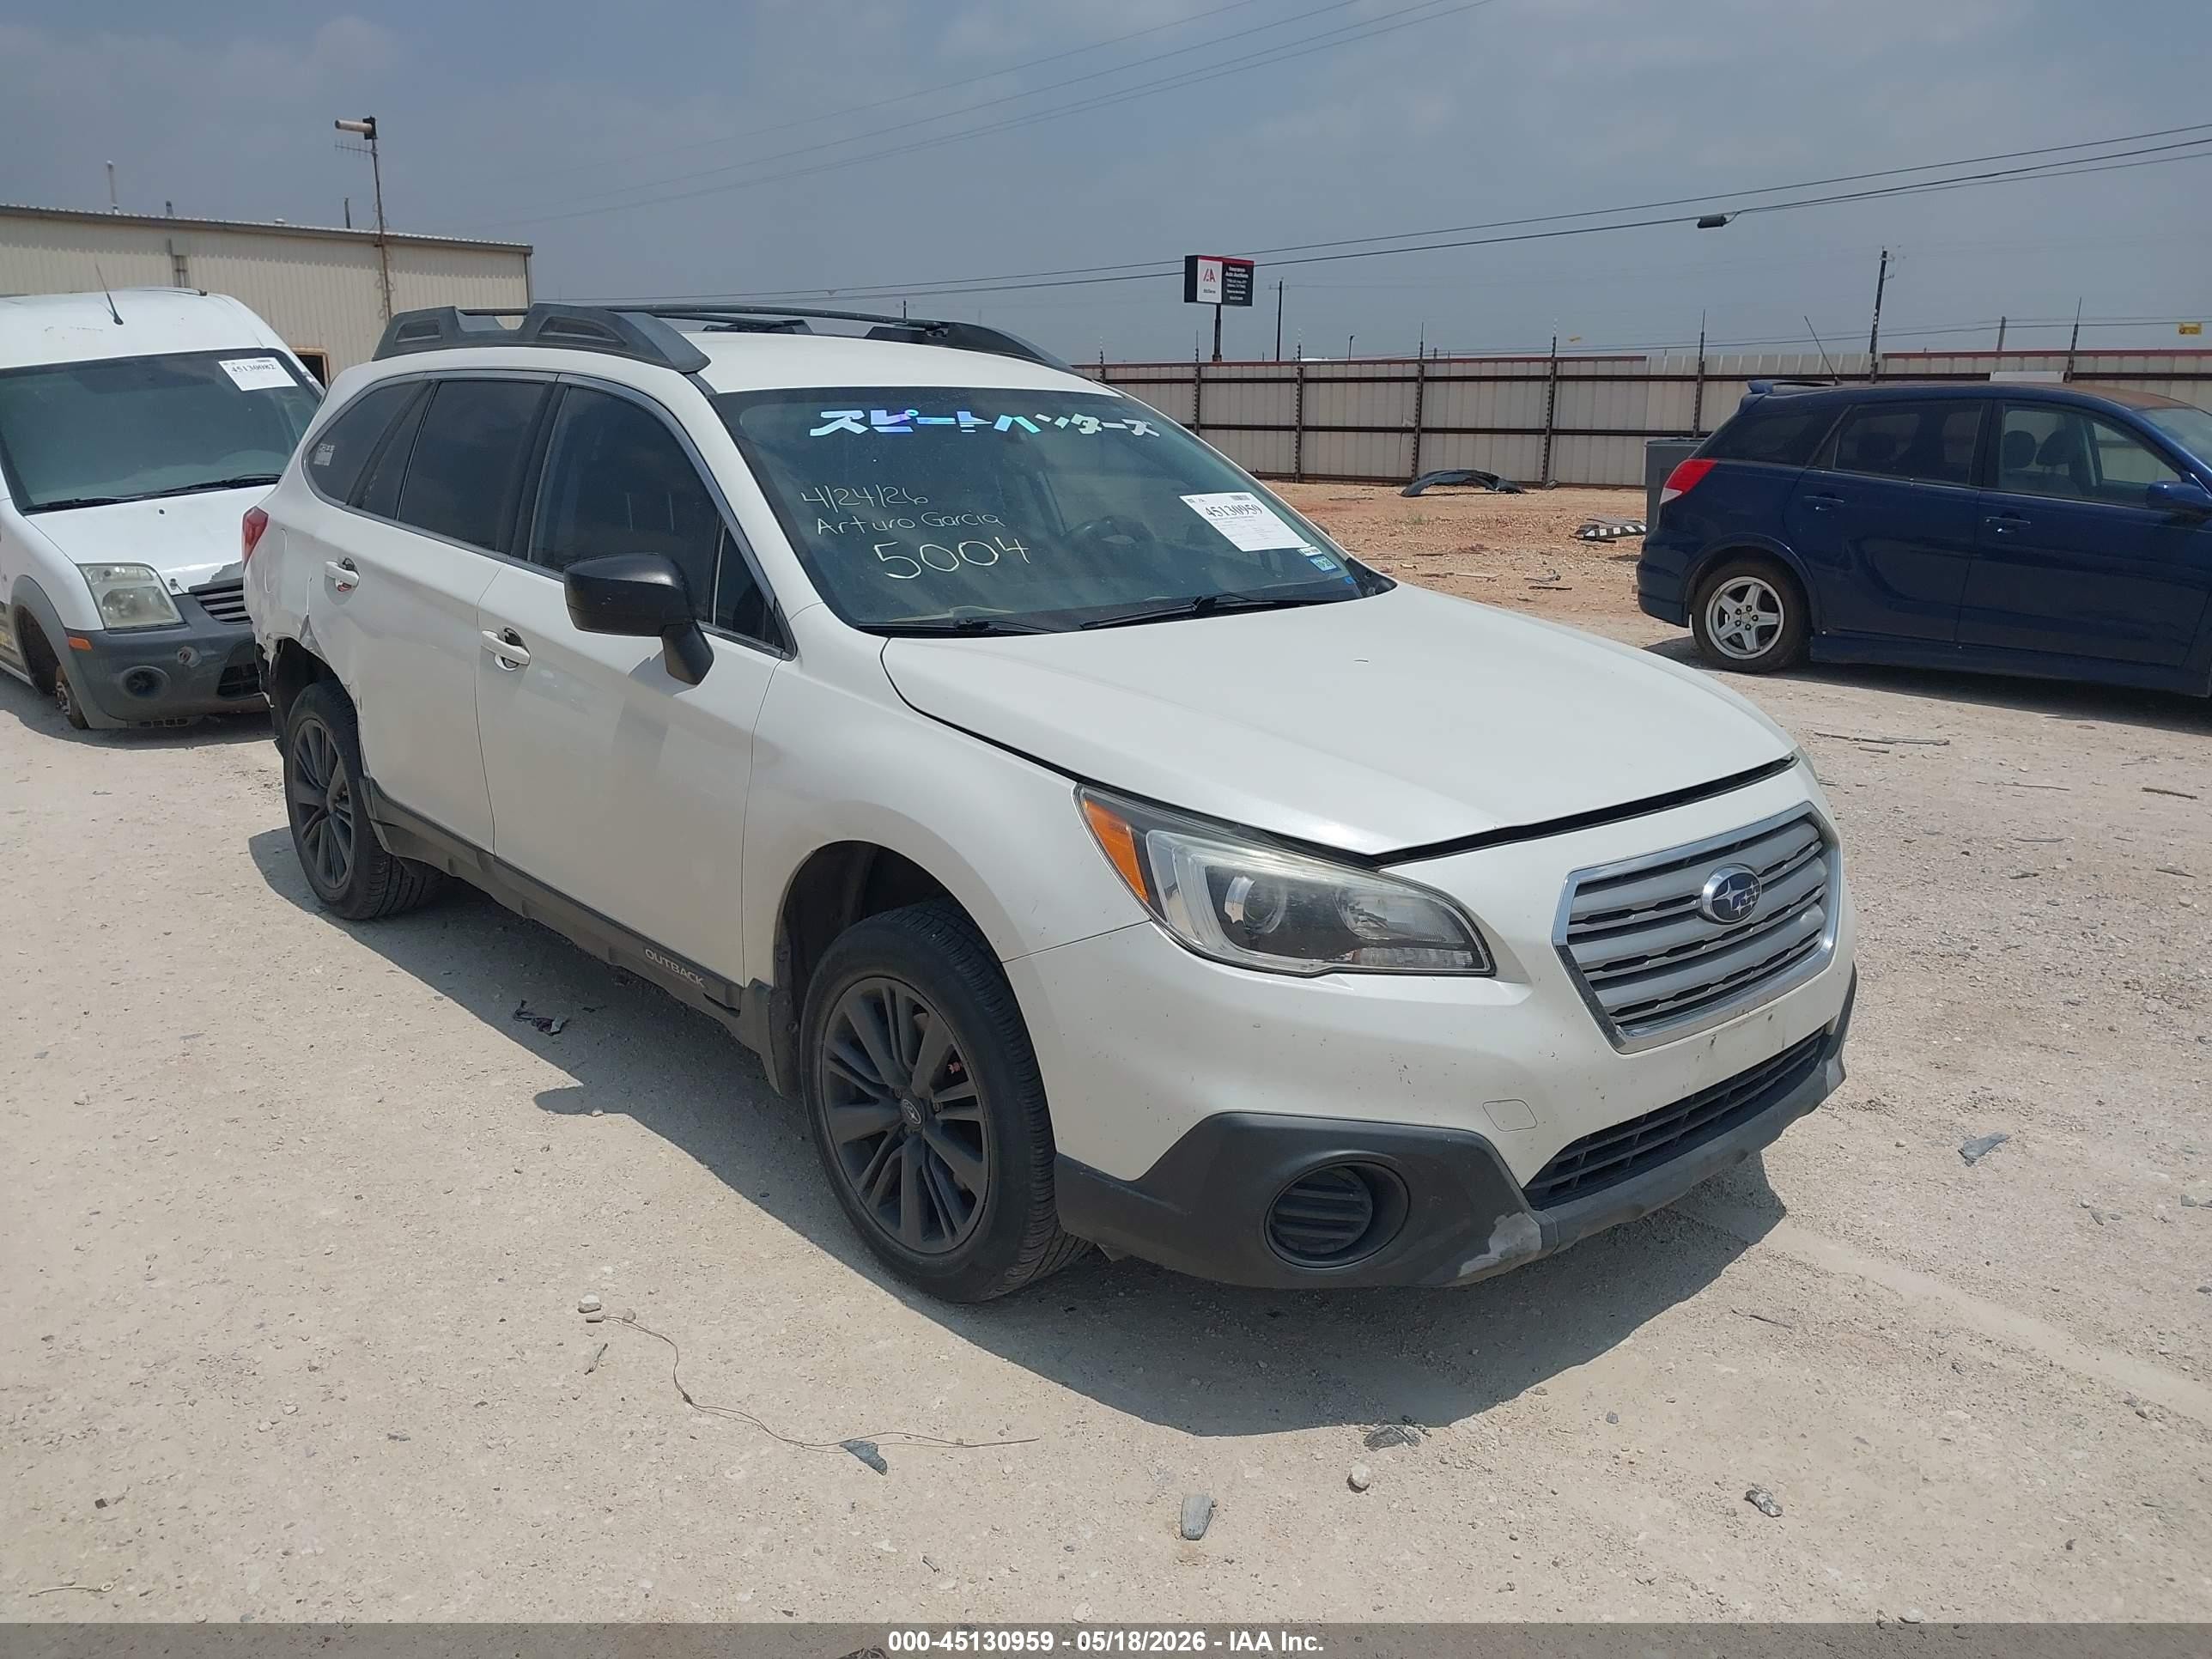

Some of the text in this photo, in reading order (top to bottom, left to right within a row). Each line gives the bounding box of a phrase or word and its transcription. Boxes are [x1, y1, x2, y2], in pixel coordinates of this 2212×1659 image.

[800, 484, 928, 514] 4/24/26
[1205, 504, 1263, 517] 45130959
[817, 510, 1006, 535] Arturo Garcia
[873, 537, 1030, 579] 5004
[645, 948, 705, 988] OUTBACK
